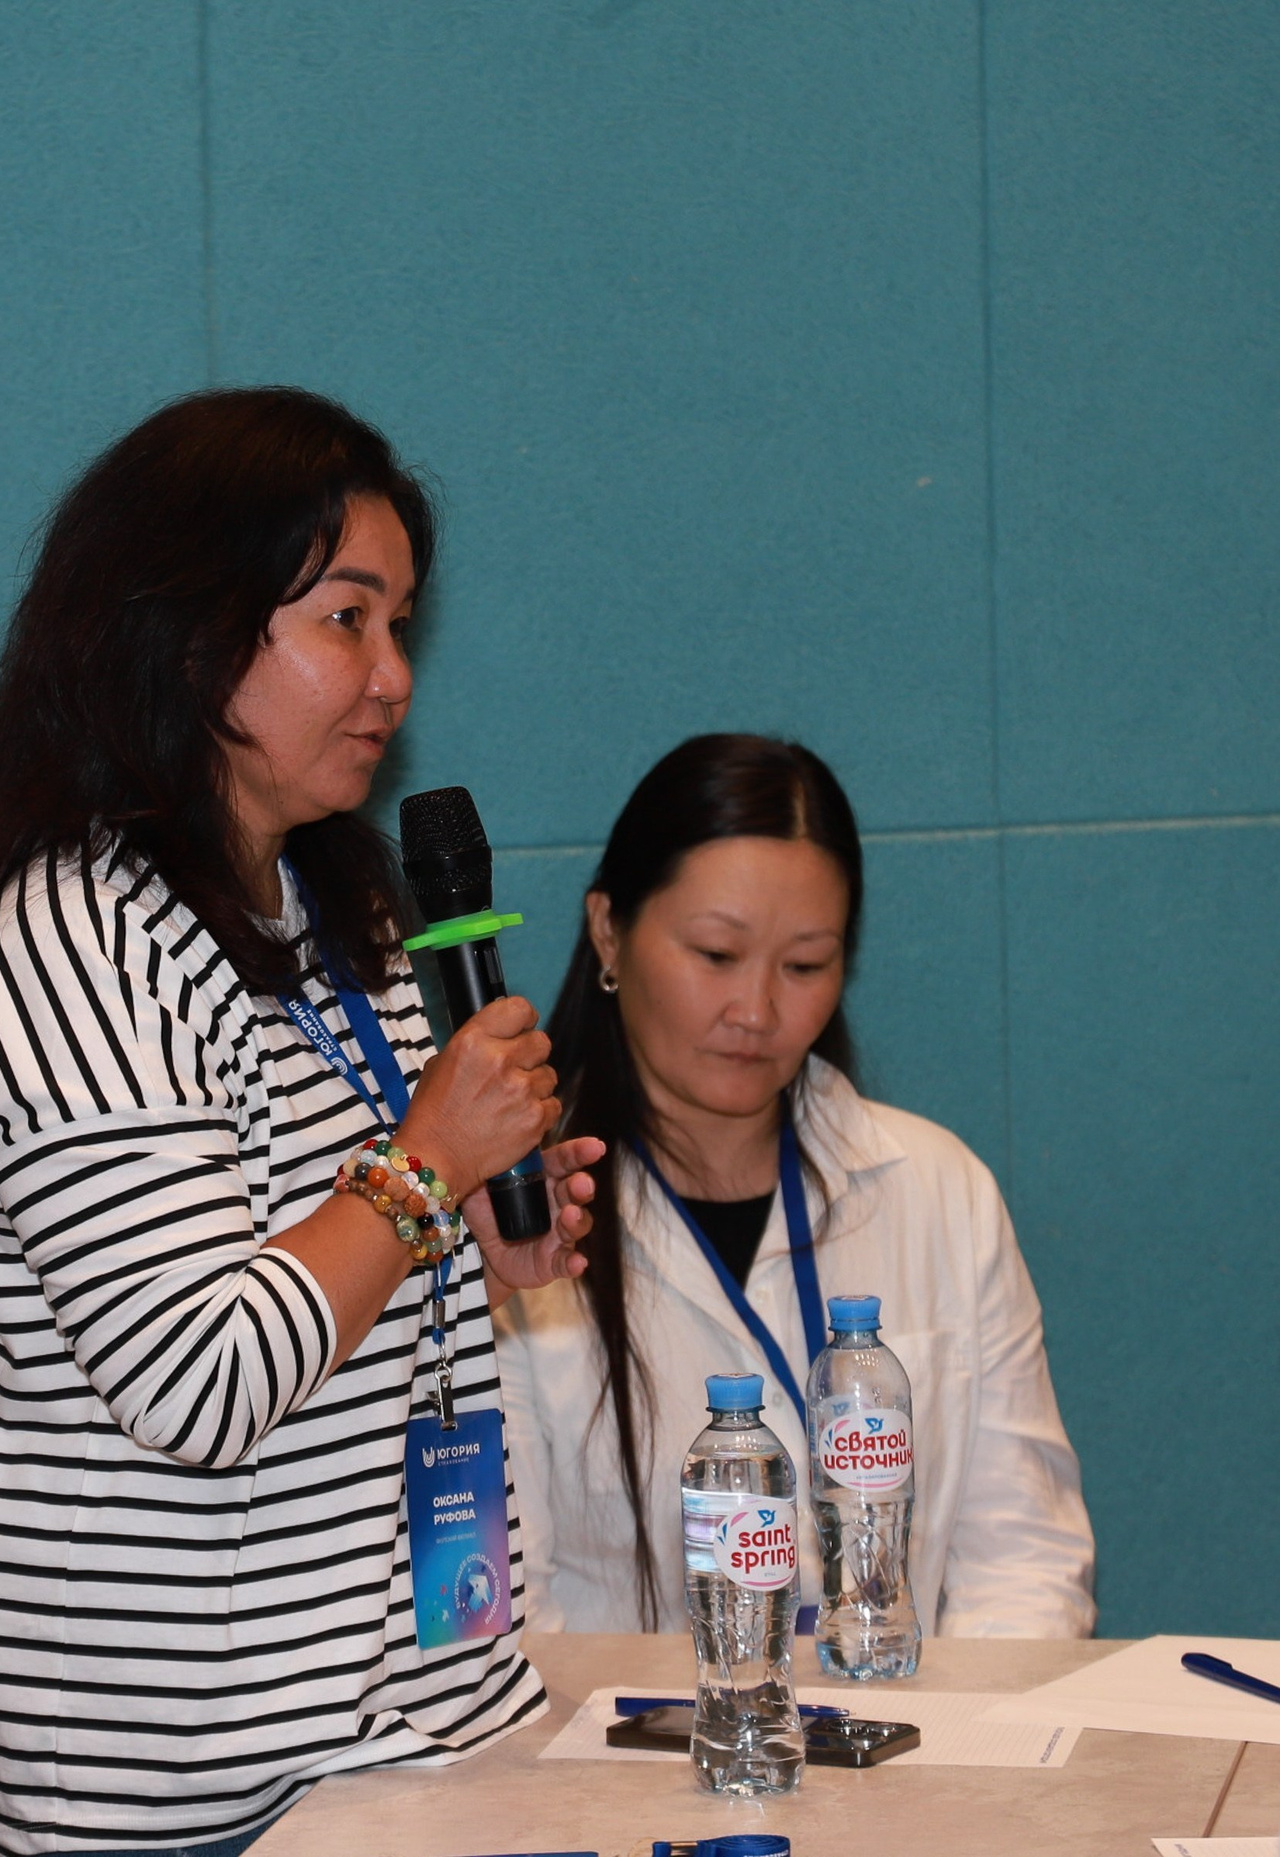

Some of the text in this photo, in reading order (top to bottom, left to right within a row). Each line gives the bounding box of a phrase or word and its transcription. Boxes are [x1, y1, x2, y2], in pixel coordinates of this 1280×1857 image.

[288, 999, 333, 1056] ЮГОРИЯ
[437, 1443, 480, 1460] ЮГОРИЯ
[433, 1491, 475, 1508] ОКСАНА
[434, 1509, 476, 1525] РУФОВА
[738, 1524, 791, 1548] saint
[731, 1545, 795, 1574] spring
